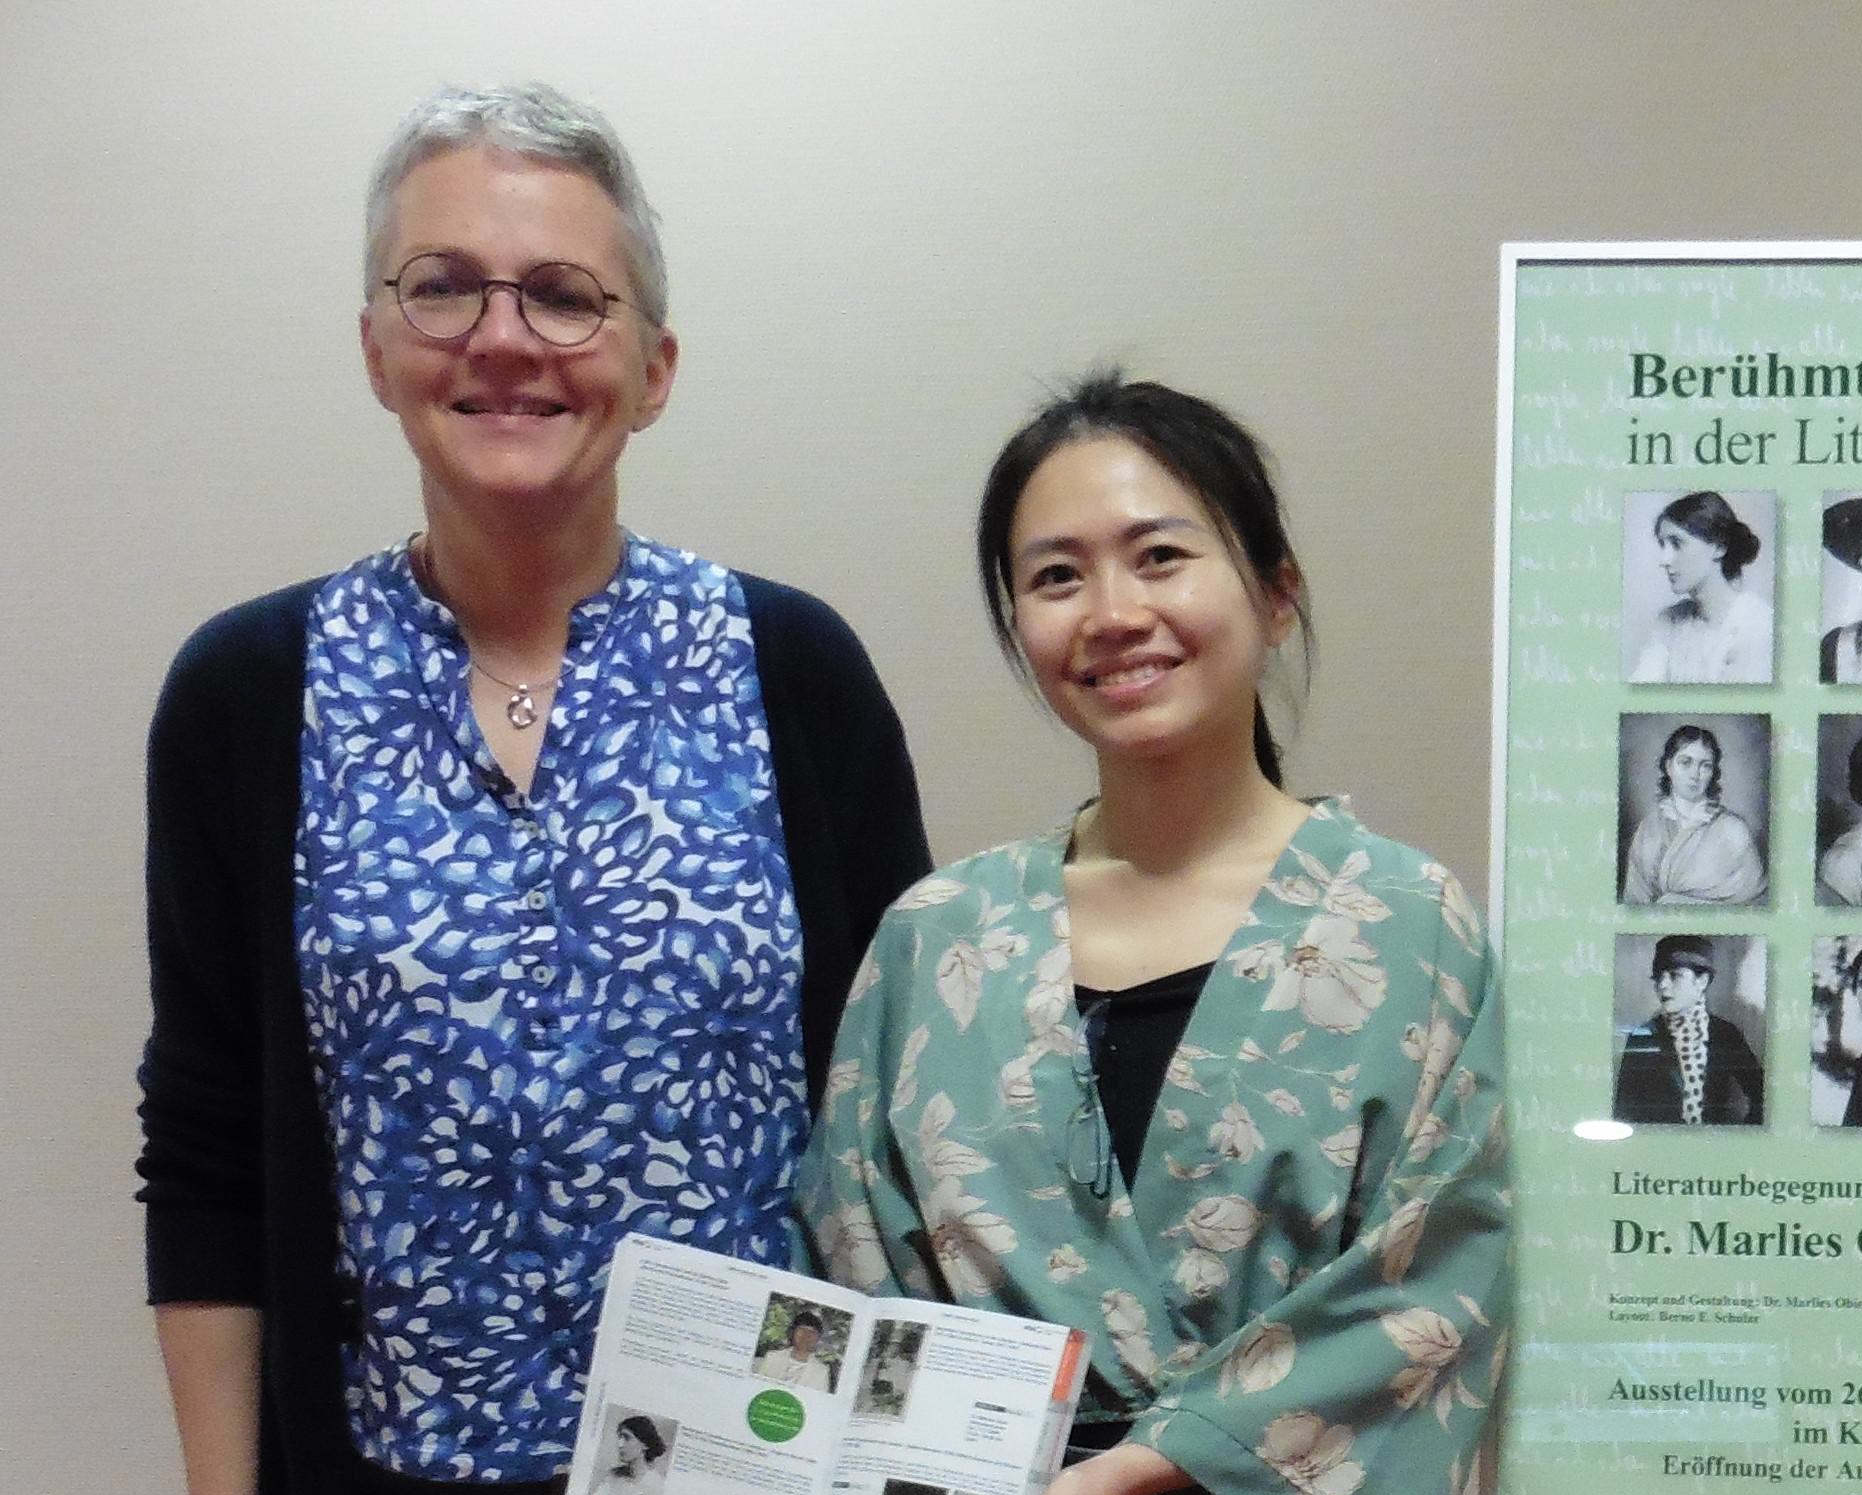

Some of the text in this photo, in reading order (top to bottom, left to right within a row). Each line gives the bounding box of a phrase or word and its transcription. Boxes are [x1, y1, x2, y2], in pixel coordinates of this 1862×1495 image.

[1627, 417, 1673, 464] in
[1694, 417, 1776, 465] der
[1611, 1219, 1672, 1254] Dr.
[1688, 1221, 1842, 1258] Marlies
[1609, 1293, 1659, 1307] Konzept
[1662, 1294, 1686, 1306] und
[1785, 1296, 1832, 1308] Marlies
[1607, 1378, 1767, 1409] Ausstellung
[1776, 1387, 1831, 1404] vom
[1793, 1420, 1827, 1444] im
[1663, 1454, 1783, 1483] Eröffnung
[1790, 1458, 1828, 1479] der
